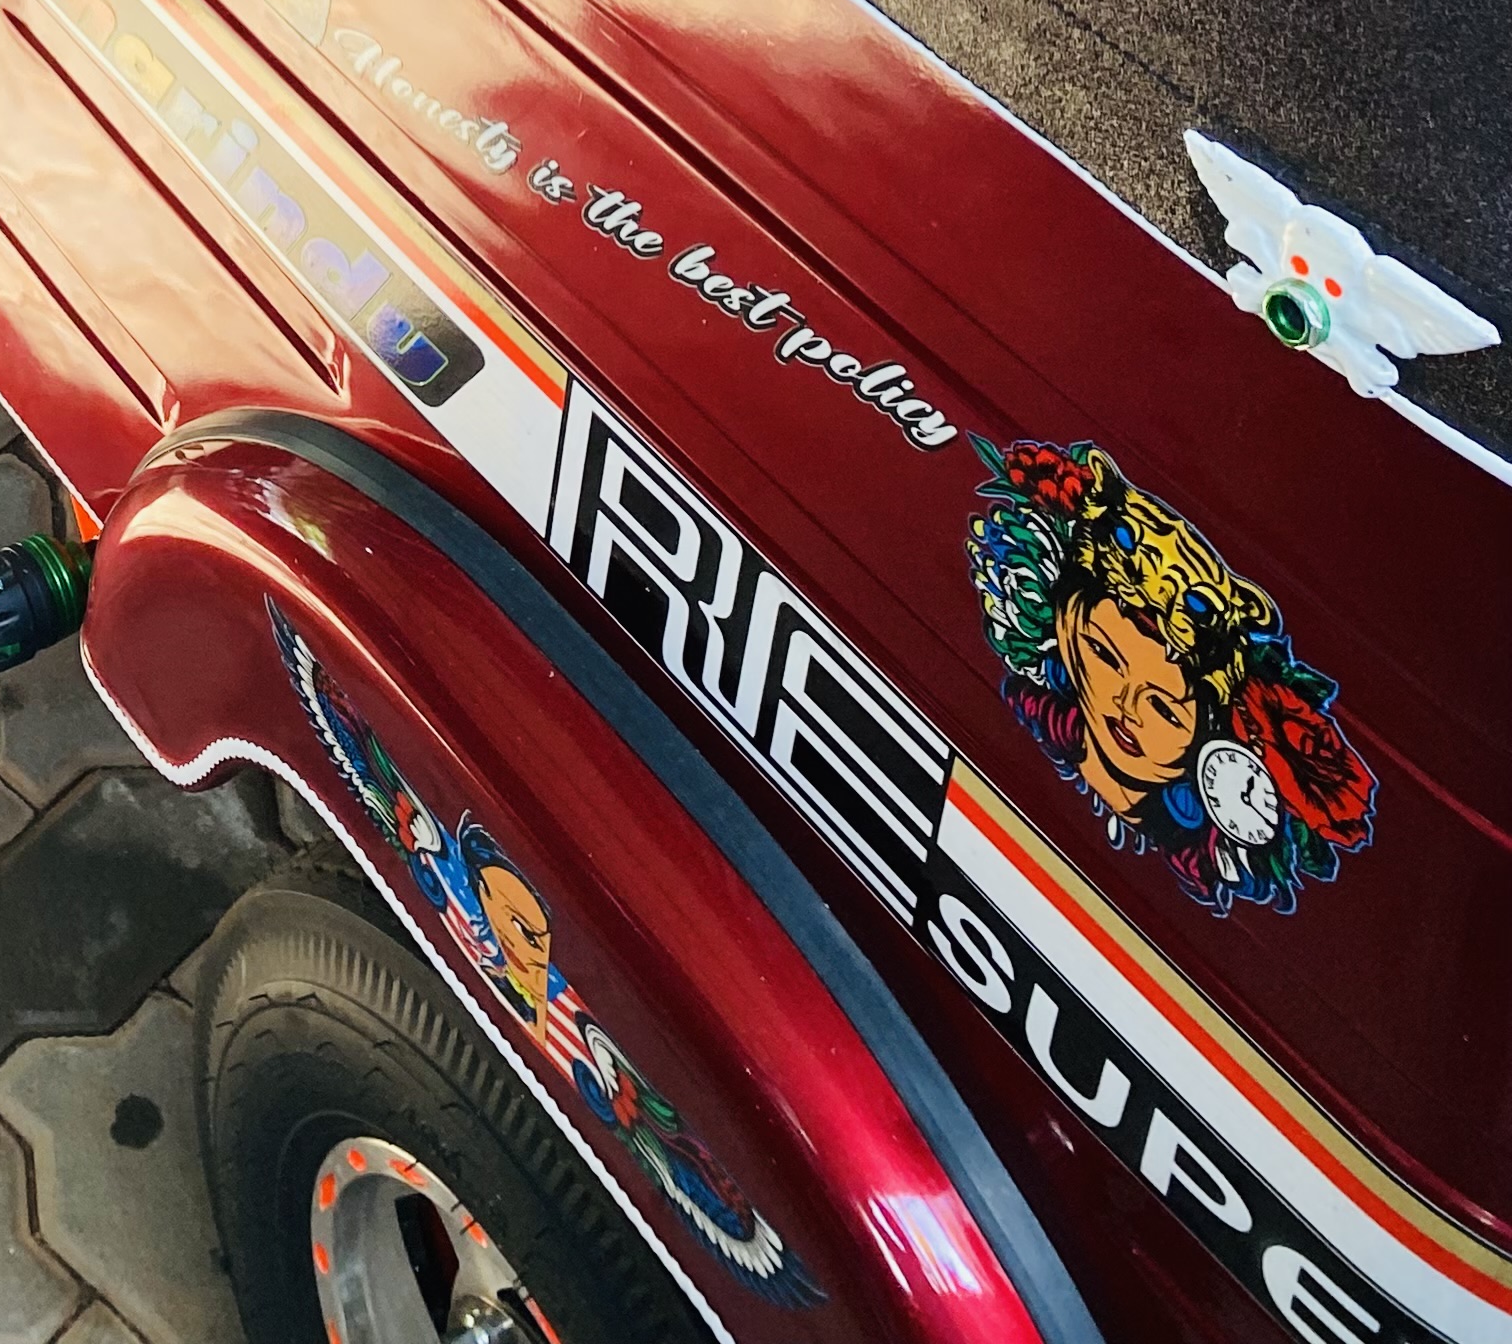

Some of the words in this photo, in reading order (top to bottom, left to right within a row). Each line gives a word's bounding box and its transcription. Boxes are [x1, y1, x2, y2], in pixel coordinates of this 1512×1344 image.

[333, 27, 524, 176] Honesty
[527, 158, 578, 205] is
[581, 182, 665, 260] the
[668, 242, 807, 332] best
[774, 323, 959, 452] policy
[926, 893, 1410, 1344] SUPE
